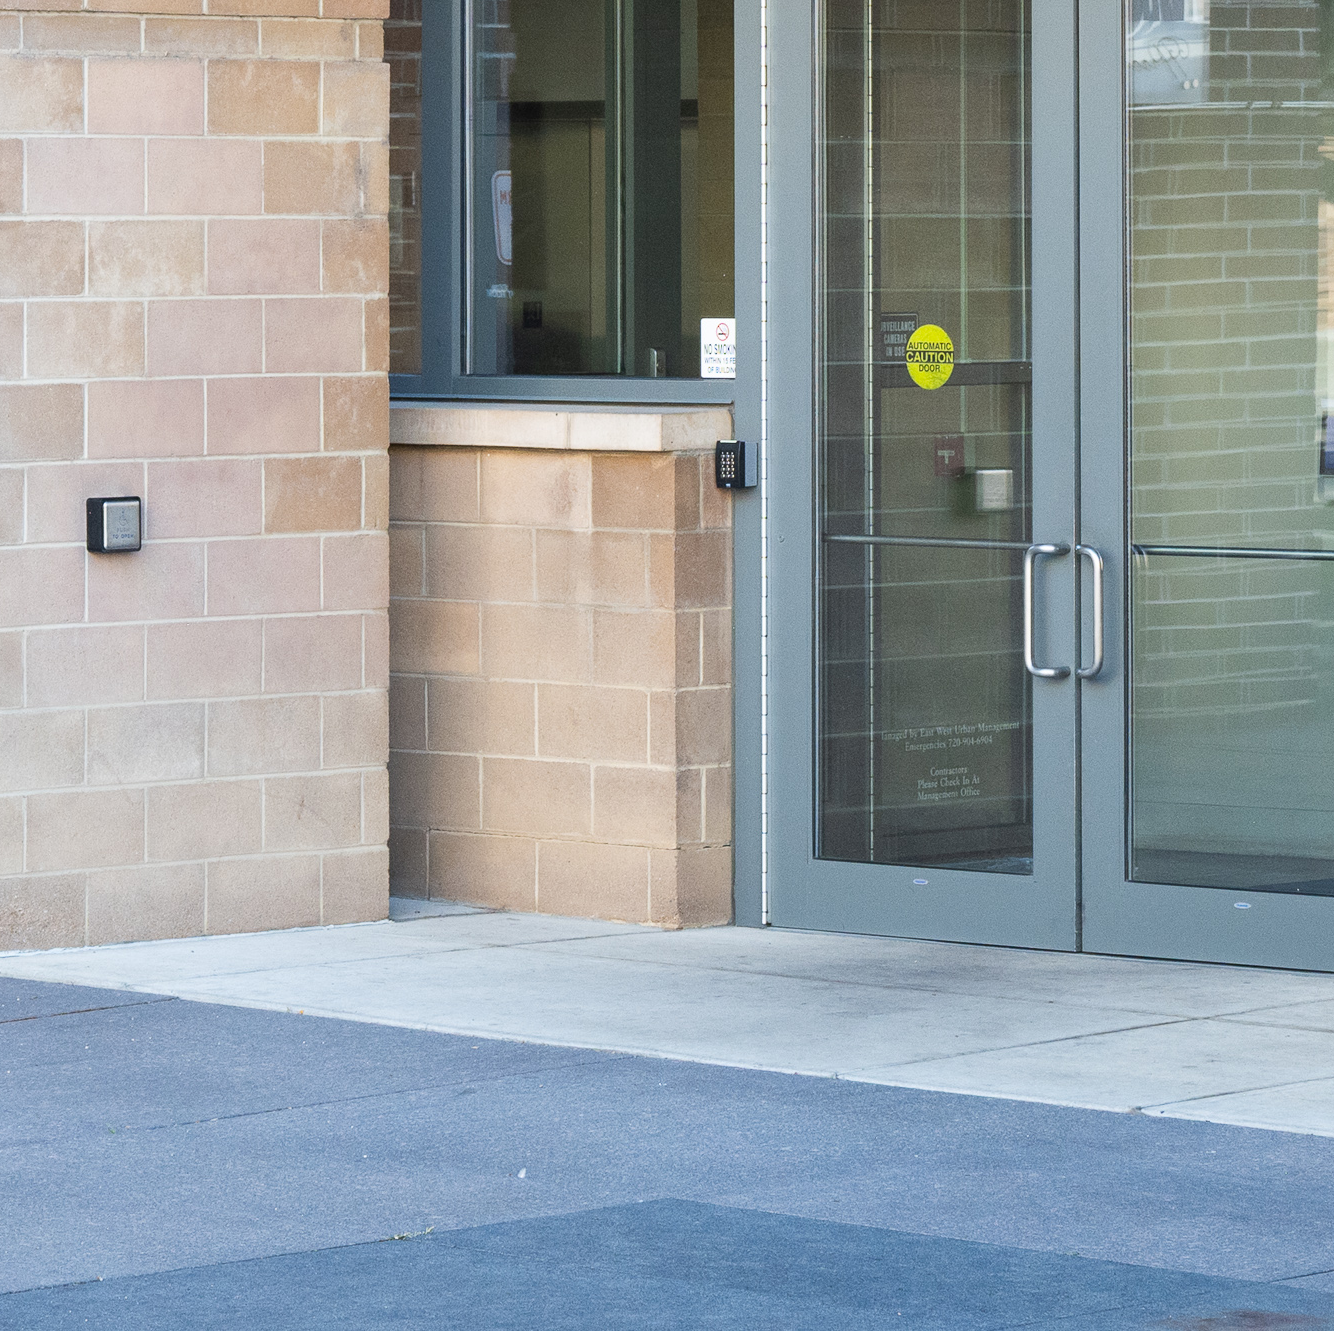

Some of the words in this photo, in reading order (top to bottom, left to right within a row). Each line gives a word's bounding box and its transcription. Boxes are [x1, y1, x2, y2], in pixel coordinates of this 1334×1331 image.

[884, 334, 907, 344] CAMERAS
[704, 344, 712, 355] NO
[894, 347, 905, 356] USE
[908, 342, 952, 350] AUTOMATIC
[906, 351, 954, 363] CAUTION
[919, 364, 941, 372] DOOR
[920, 727, 934, 737] East
[936, 725, 952, 735] West
[954, 724, 976, 734] Urban
[977, 721, 1020, 733] Management
[905, 740, 946, 752] Emergencies
[930, 767, 968, 776] Contractors
[917, 779, 938, 789] Please
[940, 776, 960, 787] Check
[972, 774, 980, 784] At
[917, 791, 959, 801] Management
[960, 786, 980, 796] Office
